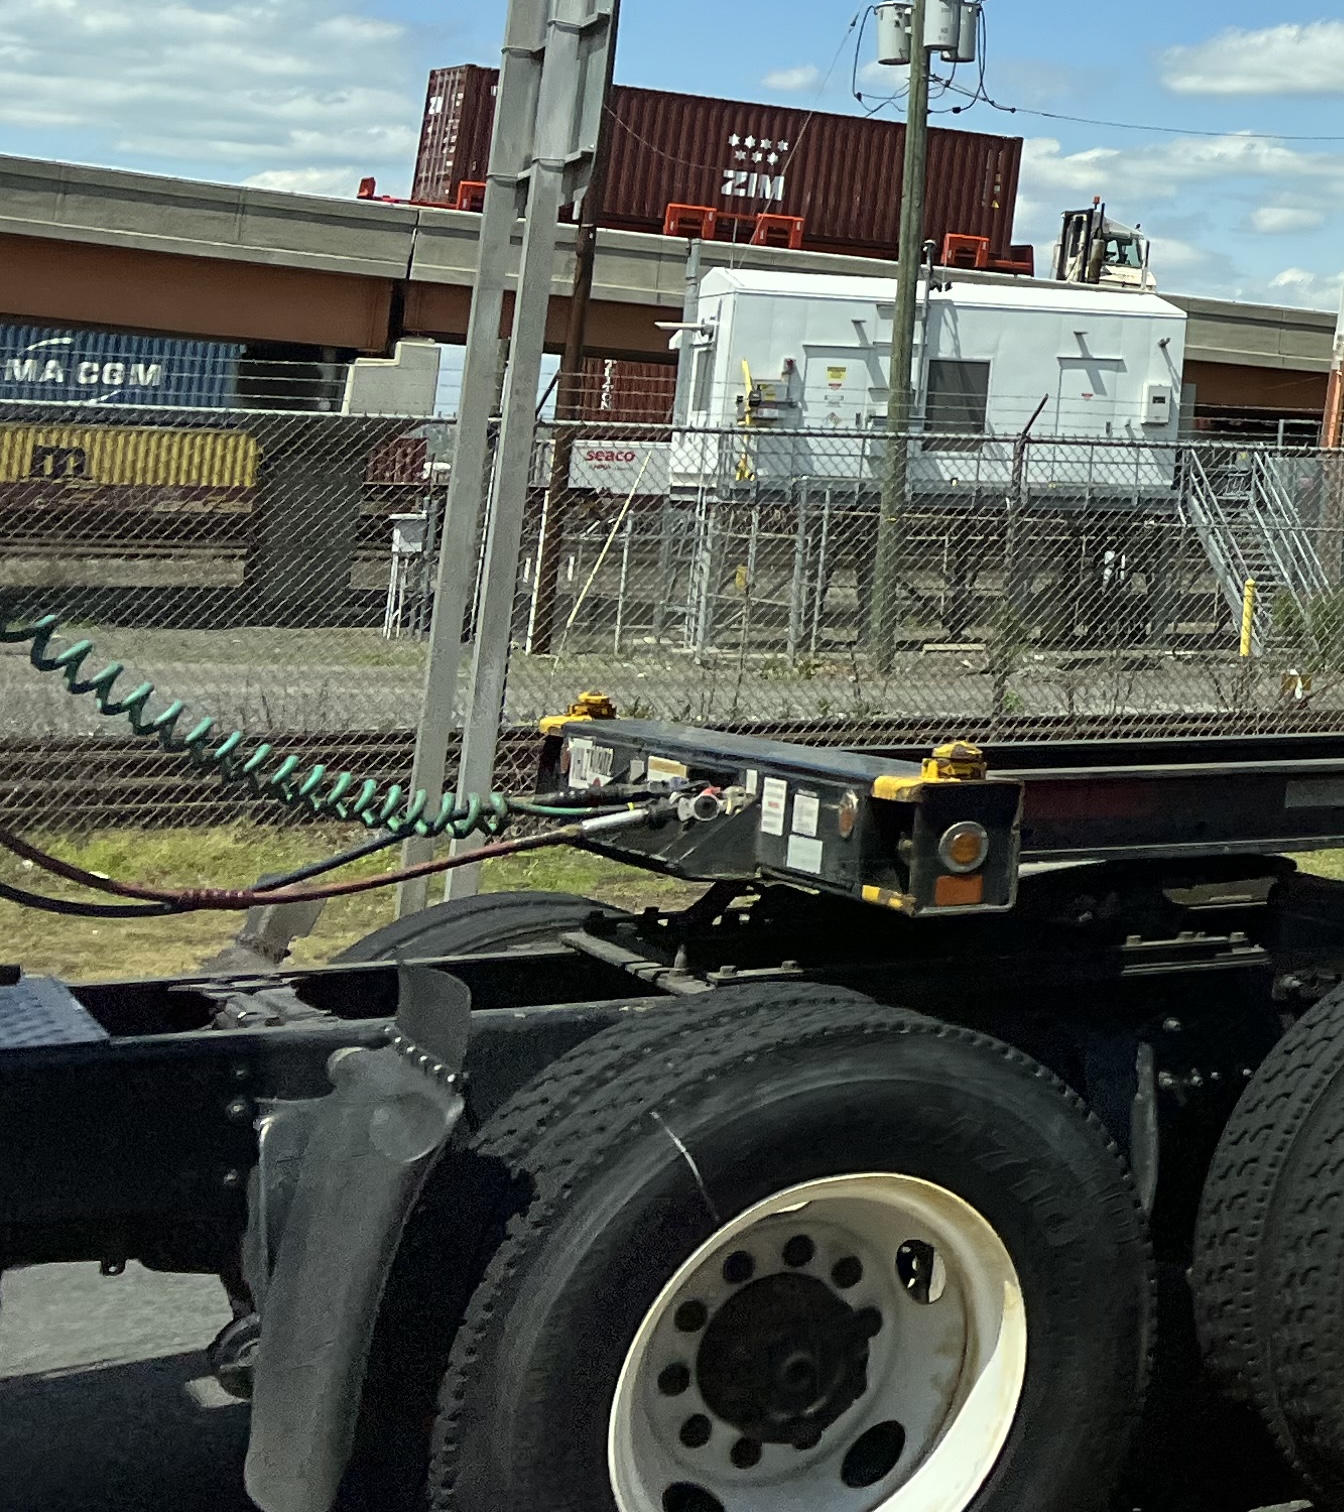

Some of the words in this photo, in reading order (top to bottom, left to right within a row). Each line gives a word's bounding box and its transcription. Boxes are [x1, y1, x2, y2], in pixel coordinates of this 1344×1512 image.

[721, 169, 784, 201] ZIM
[77, 361, 162, 386] CGM
[586, 450, 635, 463] seaco
